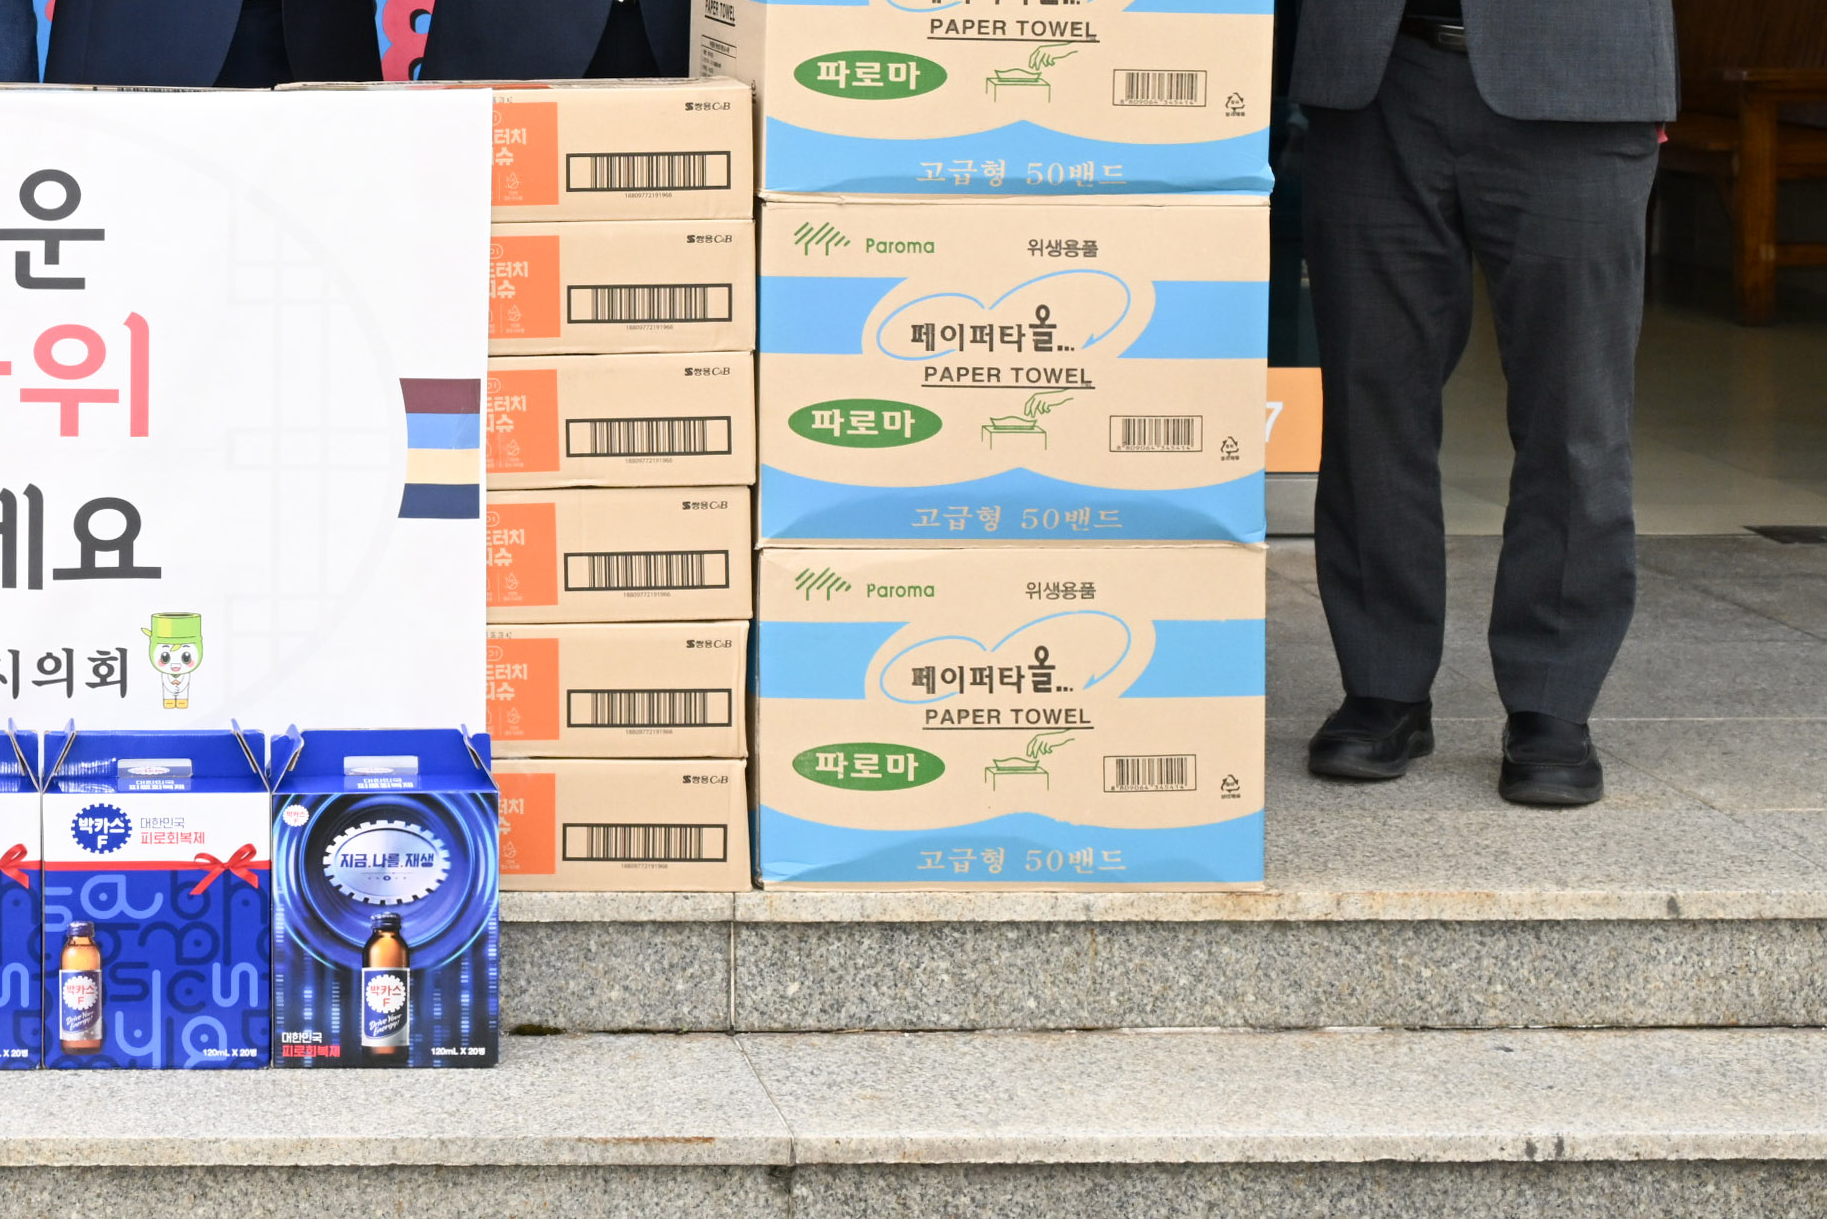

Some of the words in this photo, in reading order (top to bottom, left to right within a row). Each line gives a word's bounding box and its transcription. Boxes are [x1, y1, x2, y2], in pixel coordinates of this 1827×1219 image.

[930, 19, 1007, 35] PAPER
[1018, 20, 1098, 38] TOWEL
[817, 61, 920, 90] 파로마
[916, 160, 1006, 184] 고급형
[1027, 161, 1127, 187] 50밴드
[866, 238, 935, 254] Paroma
[924, 367, 1001, 383] PAPER
[1011, 367, 1092, 384] TOWEL
[811, 410, 915, 438] 파로마
[912, 506, 1002, 532] 고급형
[1022, 507, 1123, 531] 50밴드
[867, 583, 935, 598] Paroma
[1025, 582, 1096, 600] 위생용품
[926, 709, 1001, 725] PAPER
[1011, 708, 1091, 725] TOWEL
[815, 752, 919, 780] 파로마
[78, 818, 125, 835] 박카스
[140, 817, 185, 829] 대한민국
[140, 831, 205, 845] 피로회복제
[917, 848, 1006, 873] 고급형
[1026, 849, 1126, 872] 50밴드
[370, 986, 401, 995] 박카스
[383, 998, 390, 1007] F
[282, 1033, 322, 1044] 대한민국
[282, 1044, 340, 1058] 피로회복제
[431, 1048, 458, 1056] 120mL
[469, 1047, 486, 1056] 20병
